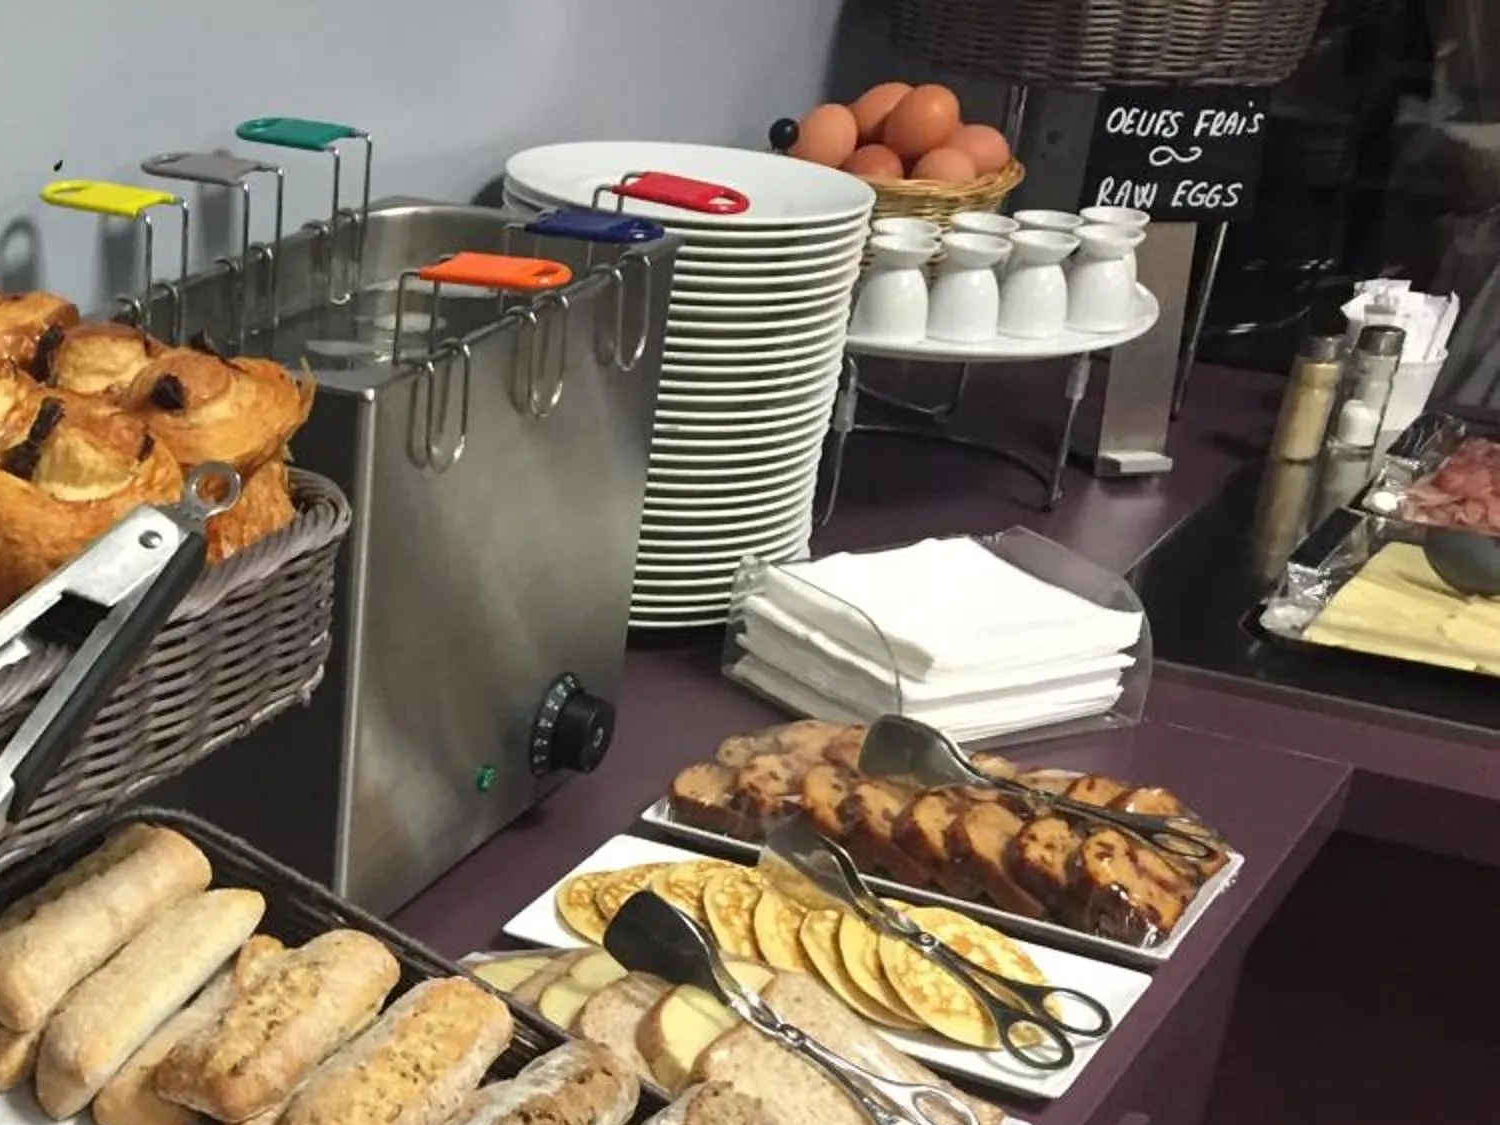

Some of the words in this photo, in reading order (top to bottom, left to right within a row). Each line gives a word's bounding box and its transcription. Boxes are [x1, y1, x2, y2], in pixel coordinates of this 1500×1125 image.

[1105, 107, 1184, 137] OEUFS
[1095, 176, 1158, 208] RAW
[1171, 180, 1243, 208] EGGS
